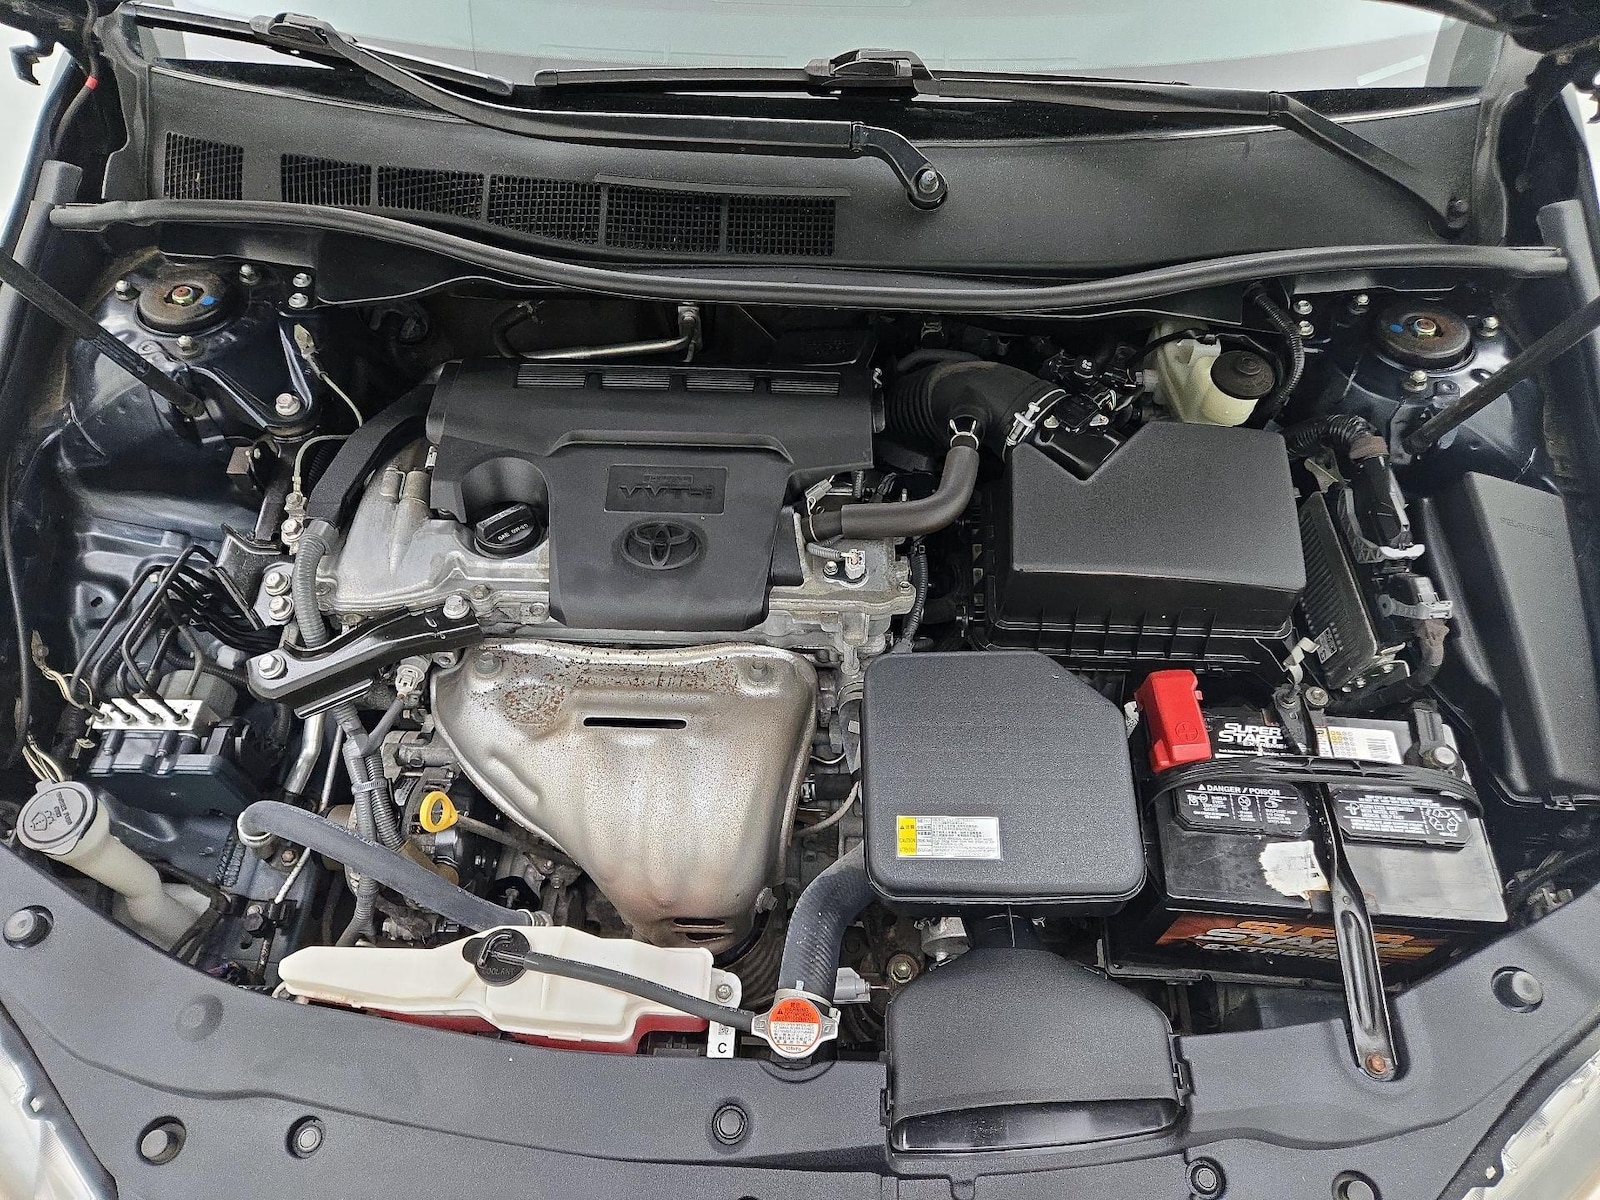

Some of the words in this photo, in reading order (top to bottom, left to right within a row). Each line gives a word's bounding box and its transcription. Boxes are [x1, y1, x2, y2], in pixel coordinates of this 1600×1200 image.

[1224, 722, 1282, 736] SUPER
[1217, 730, 1284, 744] START
[1243, 741, 1285, 750] EXTREME
[1207, 784, 1241, 793] DANGER
[1249, 787, 1281, 796] POISON
[1236, 920, 1415, 945] SUPR
[717, 1042, 727, 1054] C
